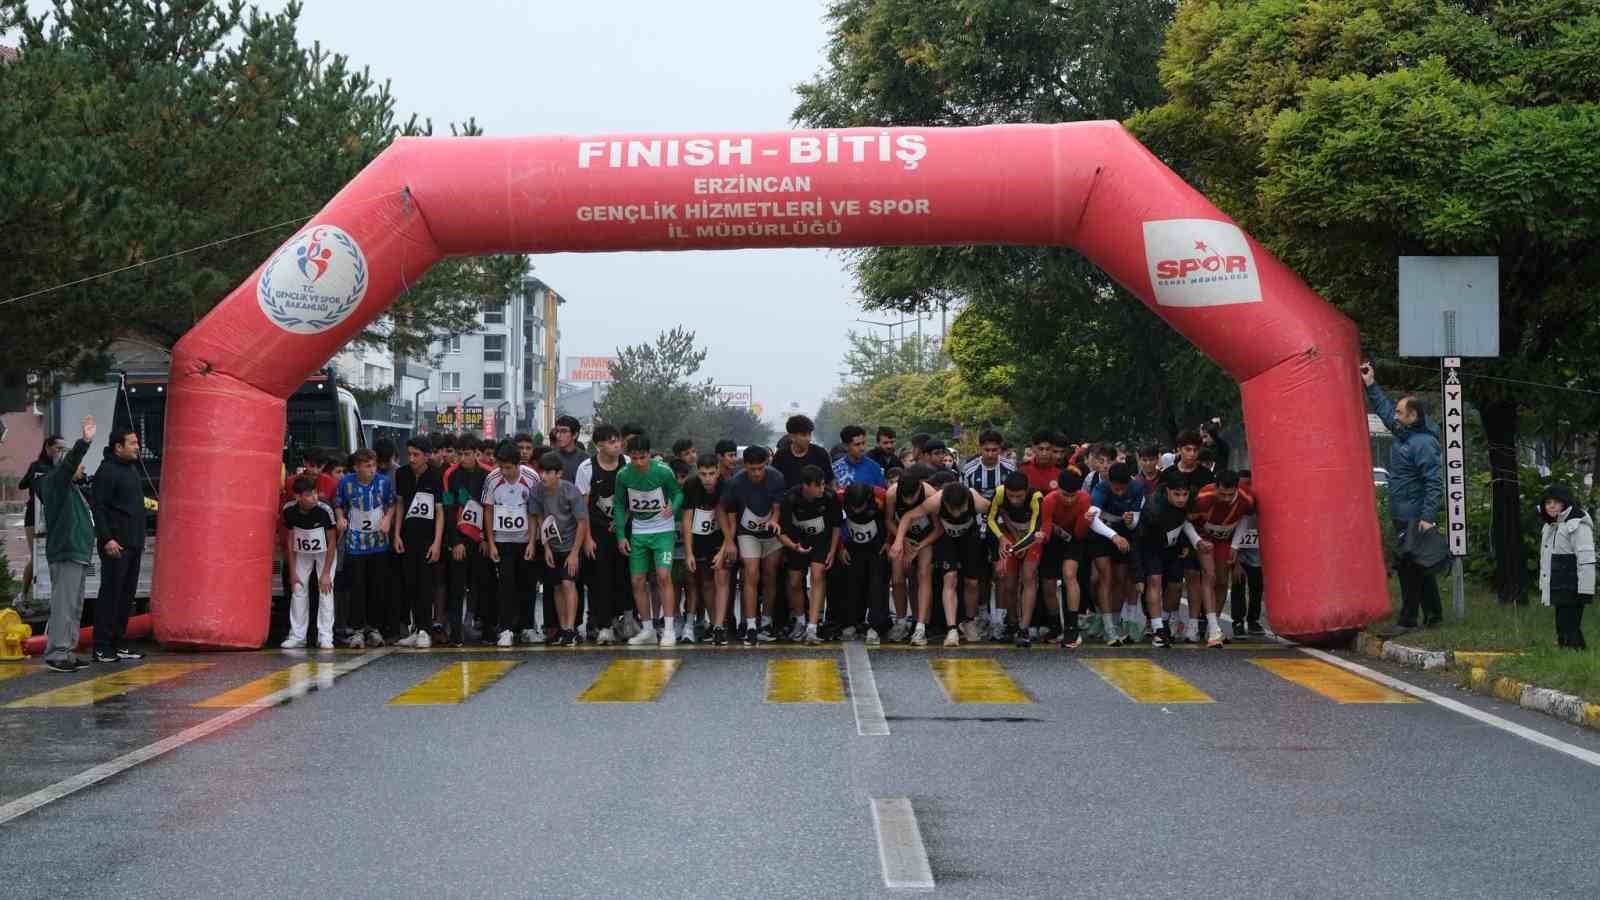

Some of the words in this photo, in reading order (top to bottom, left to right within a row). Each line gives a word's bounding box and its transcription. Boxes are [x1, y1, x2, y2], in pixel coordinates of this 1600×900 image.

[578, 138, 753, 169] FINISH
[789, 131, 928, 171] BİTİŞ
[693, 173, 812, 195] ERZİNCAN
[575, 200, 678, 223] GENÇLİK
[684, 196, 823, 220] HİZMETLERİ
[830, 199, 861, 216] VE
[868, 198, 931, 216] SPOR
[667, 223, 689, 239] İL
[696, 219, 843, 238] MÜDÜRLÜĞÜ
[1156, 254, 1248, 280] SPOR
[1447, 391, 1461, 449] YAYA
[631, 498, 662, 510] 222
[1449, 459, 1464, 547] GEÇİDİ
[362, 520, 372, 531] 2
[498, 516, 524, 529] 160
[297, 538, 322, 551] 162
